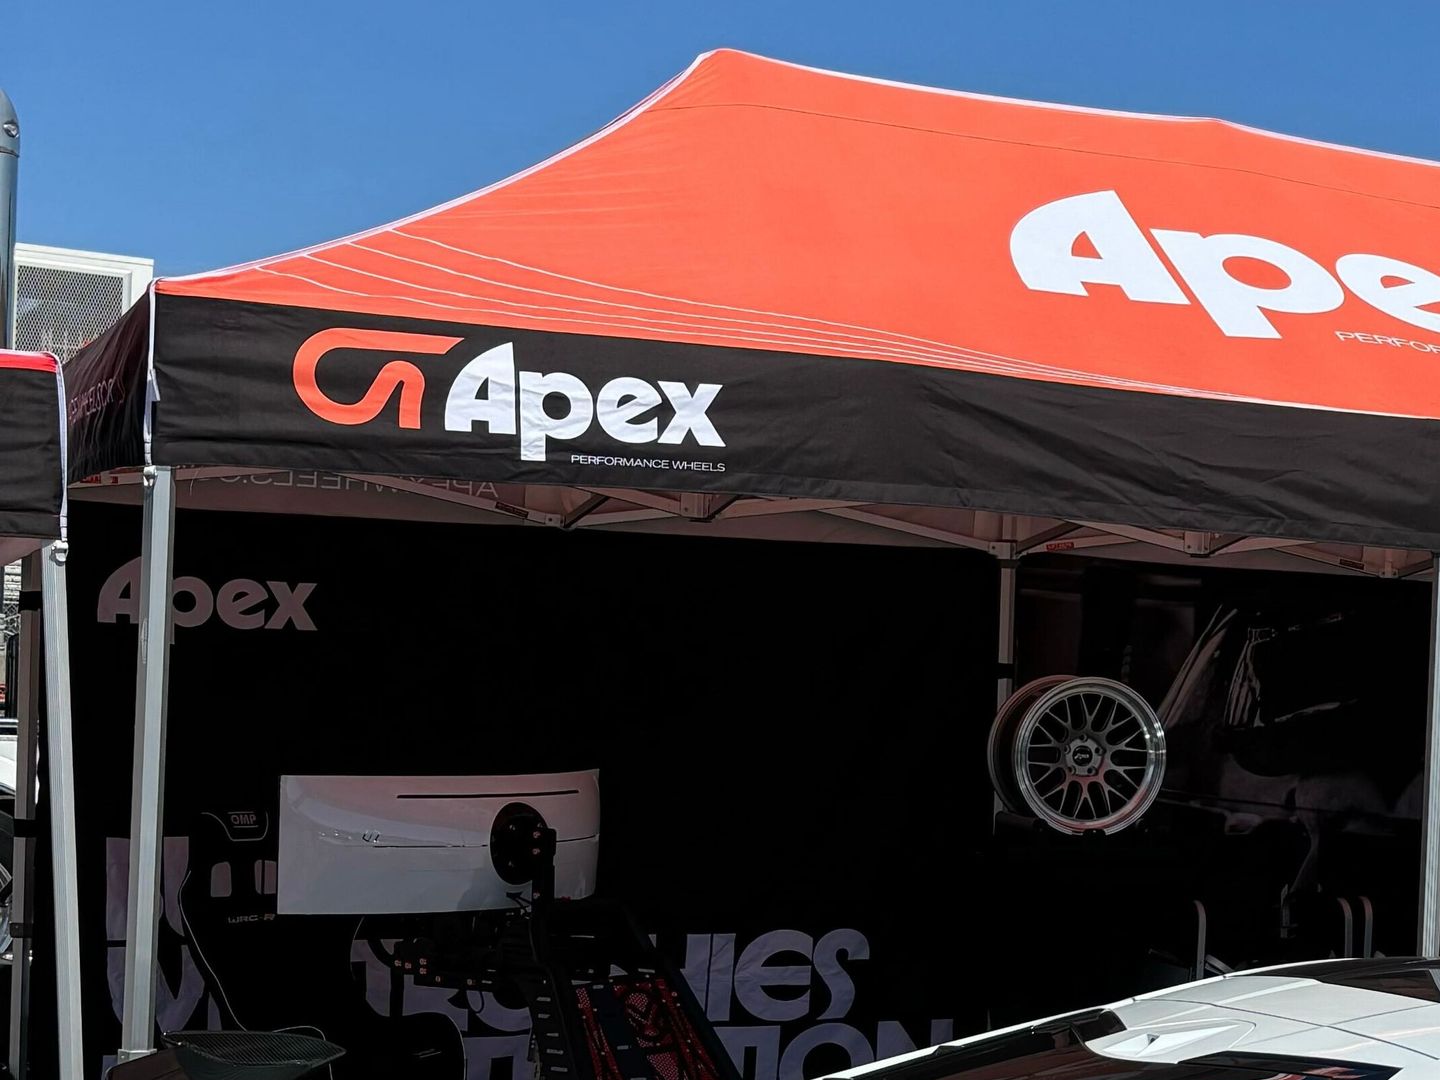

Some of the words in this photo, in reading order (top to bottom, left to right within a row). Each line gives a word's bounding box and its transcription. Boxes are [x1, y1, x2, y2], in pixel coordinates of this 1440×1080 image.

[444, 341, 727, 461] Apex
[570, 454, 670, 470] PERFORMANCE
[671, 460, 726, 472] WHEELS
[97, 555, 319, 645] Apex
[230, 814, 257, 825] OMP
